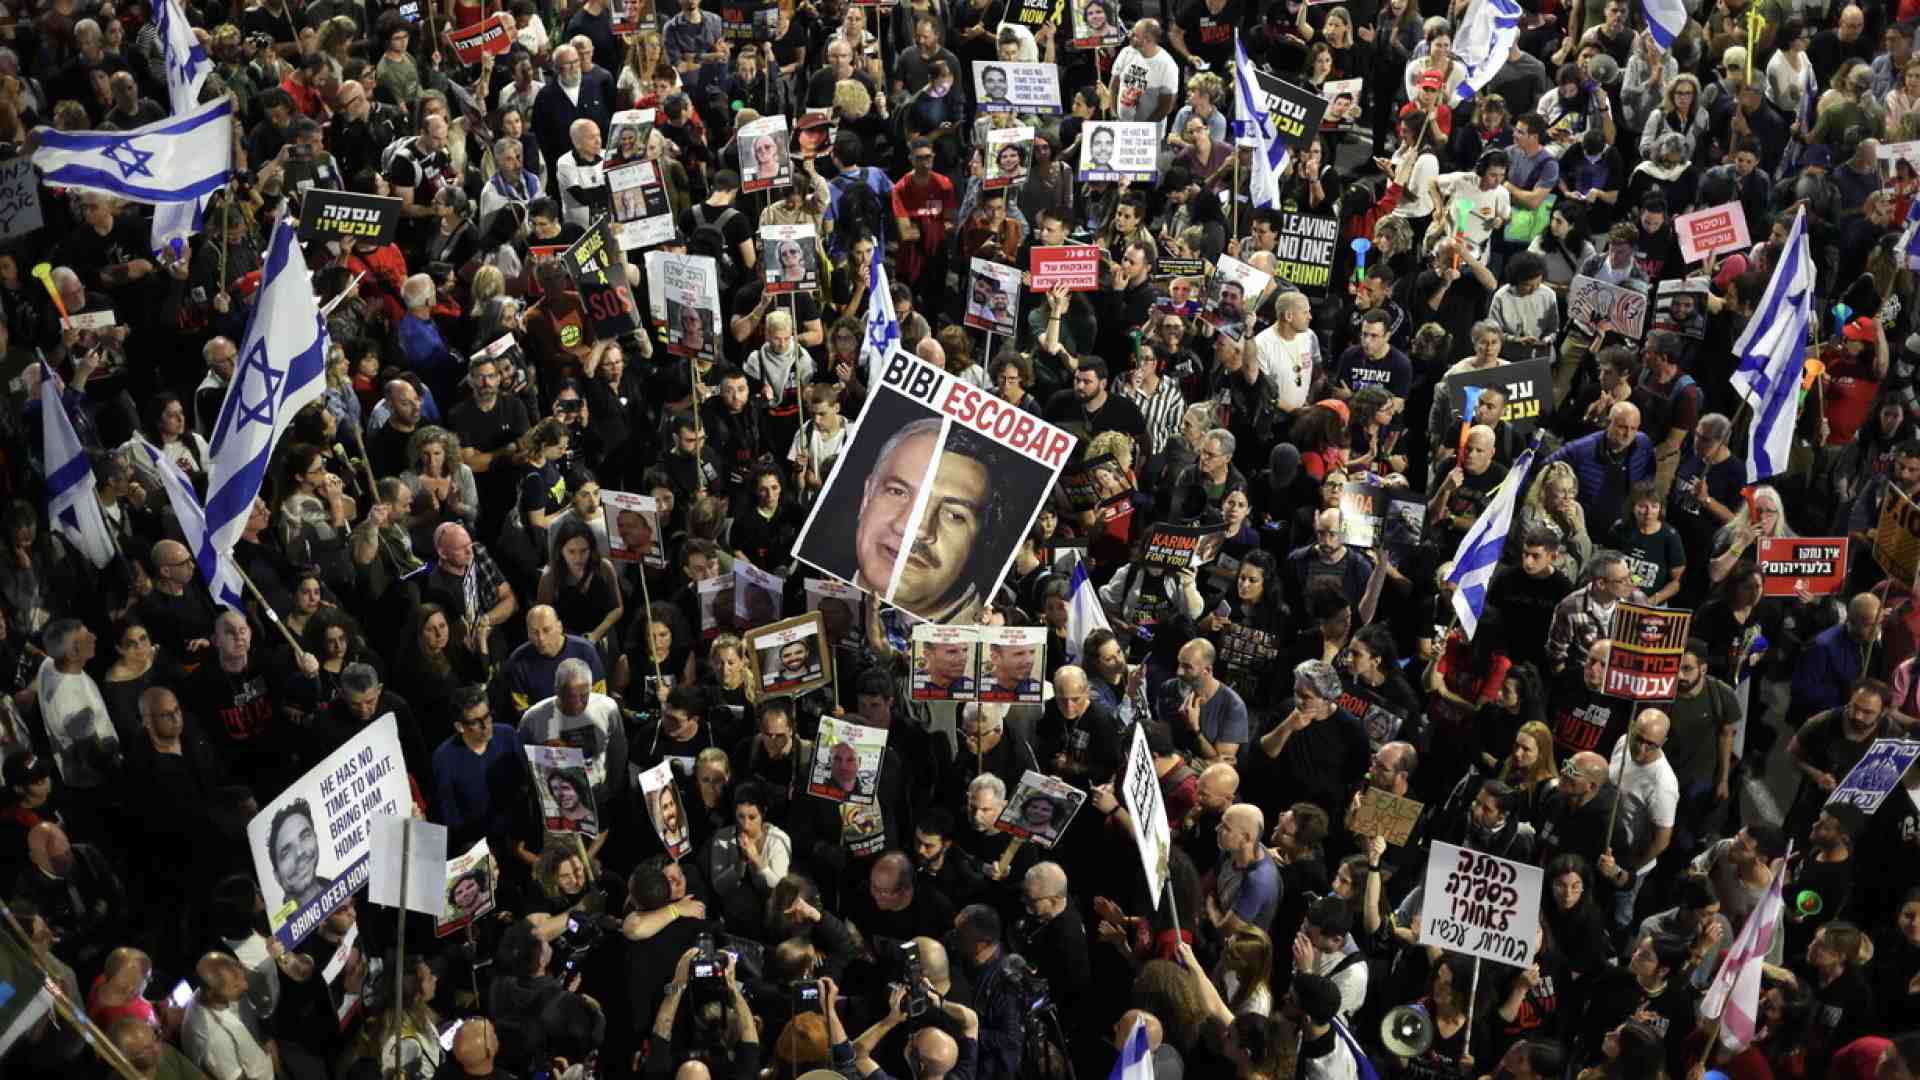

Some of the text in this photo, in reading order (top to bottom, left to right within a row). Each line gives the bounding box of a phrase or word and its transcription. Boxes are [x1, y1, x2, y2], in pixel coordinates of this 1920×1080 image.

[1018, 8, 1048, 24] NOW
[315, 217, 381, 237] עכשיו!
[323, 204, 381, 223] עסקה
[1282, 213, 1337, 240] LEAVING
[1277, 235, 1334, 265] NO ONE
[591, 286, 632, 320] SOS
[883, 352, 1070, 467] BIBI ESCOBAR
[1144, 551, 1165, 562] FOR
[1151, 532, 1199, 550] KARINA
[319, 745, 373, 799] HE HAS NO
[324, 755, 396, 818] TIME TO WAIT.
[329, 787, 384, 840] BRING HIM
[333, 829, 365, 861] HOME
[1457, 849, 1517, 885] החלה
[290, 902, 321, 942] BRING
[320, 880, 347, 912] OFER
[346, 859, 370, 893] HOM
[1449, 896, 1518, 932] לאחור!
[1430, 918, 1529, 963] בחירות עכשיו
